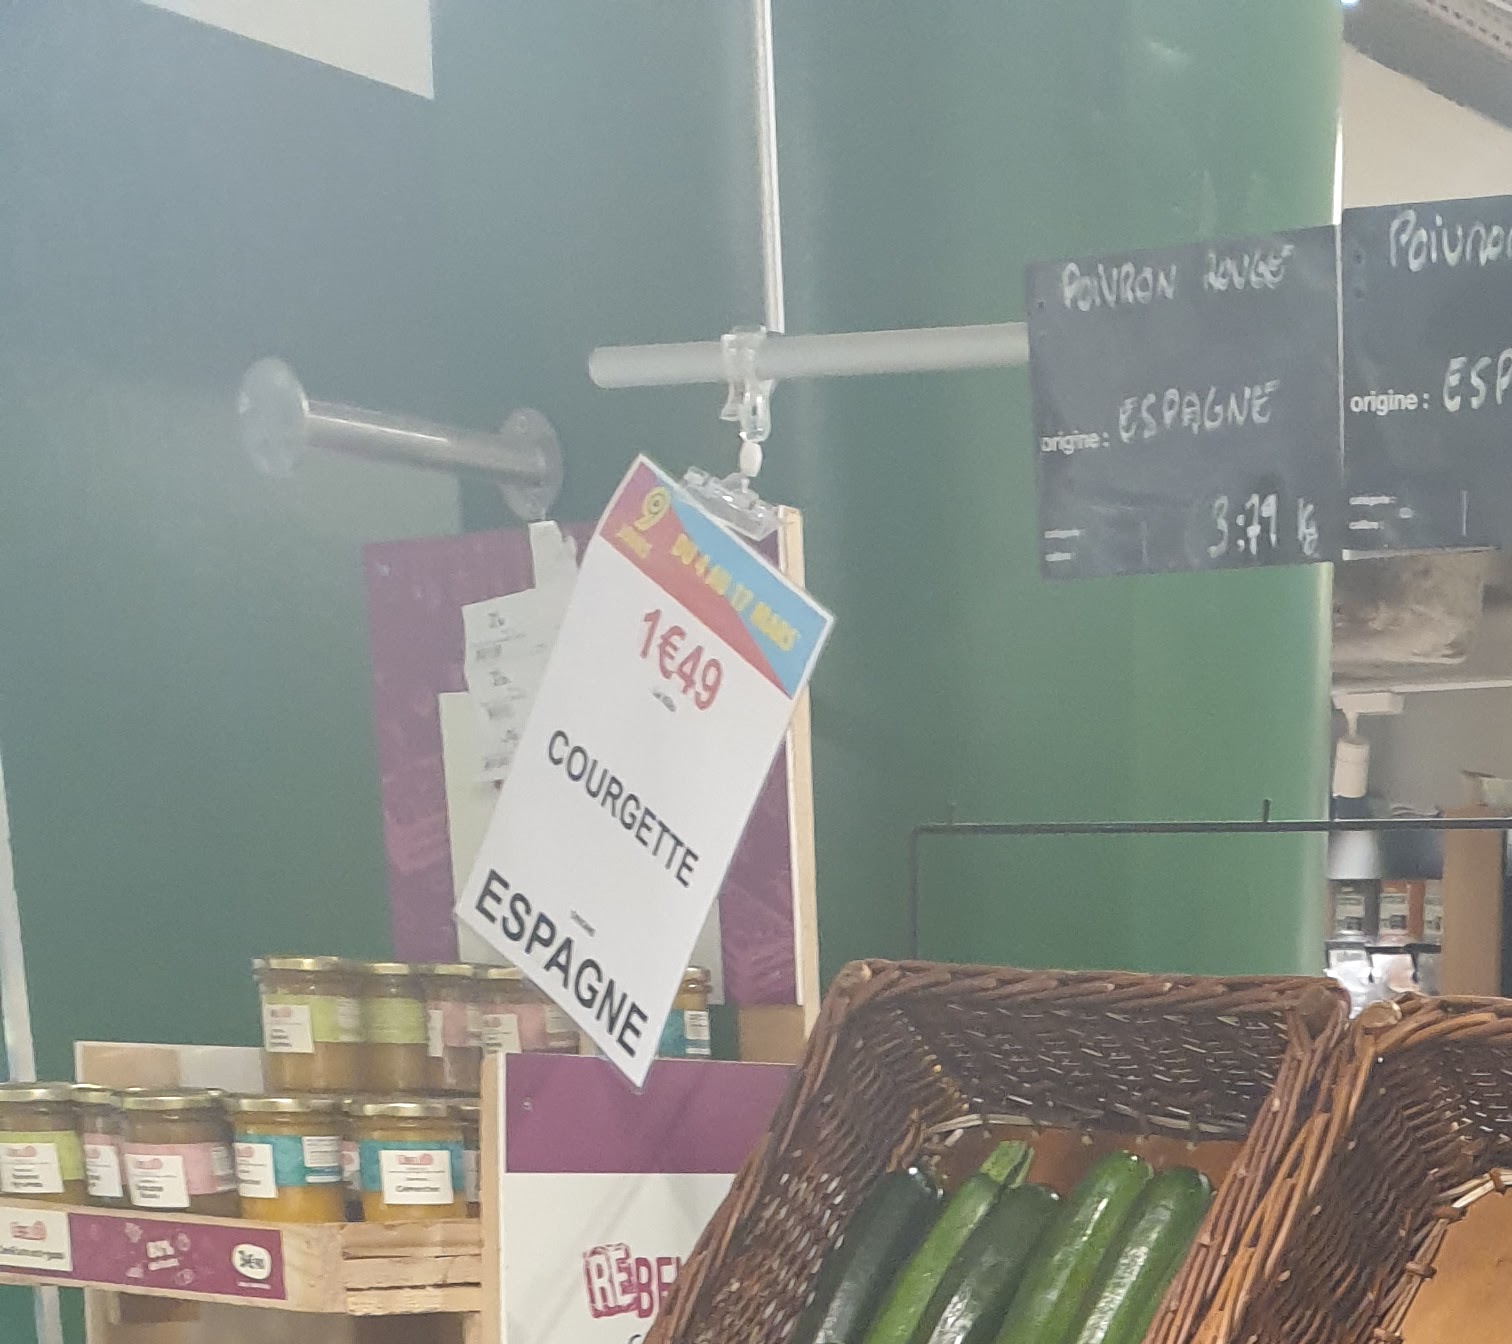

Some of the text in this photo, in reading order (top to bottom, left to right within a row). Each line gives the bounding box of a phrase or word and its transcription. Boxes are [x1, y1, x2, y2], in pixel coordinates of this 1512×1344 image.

[640, 608, 724, 710] 1€49
[547, 729, 699, 889] COURGETTE
[475, 869, 649, 1060] ESPAGNE
